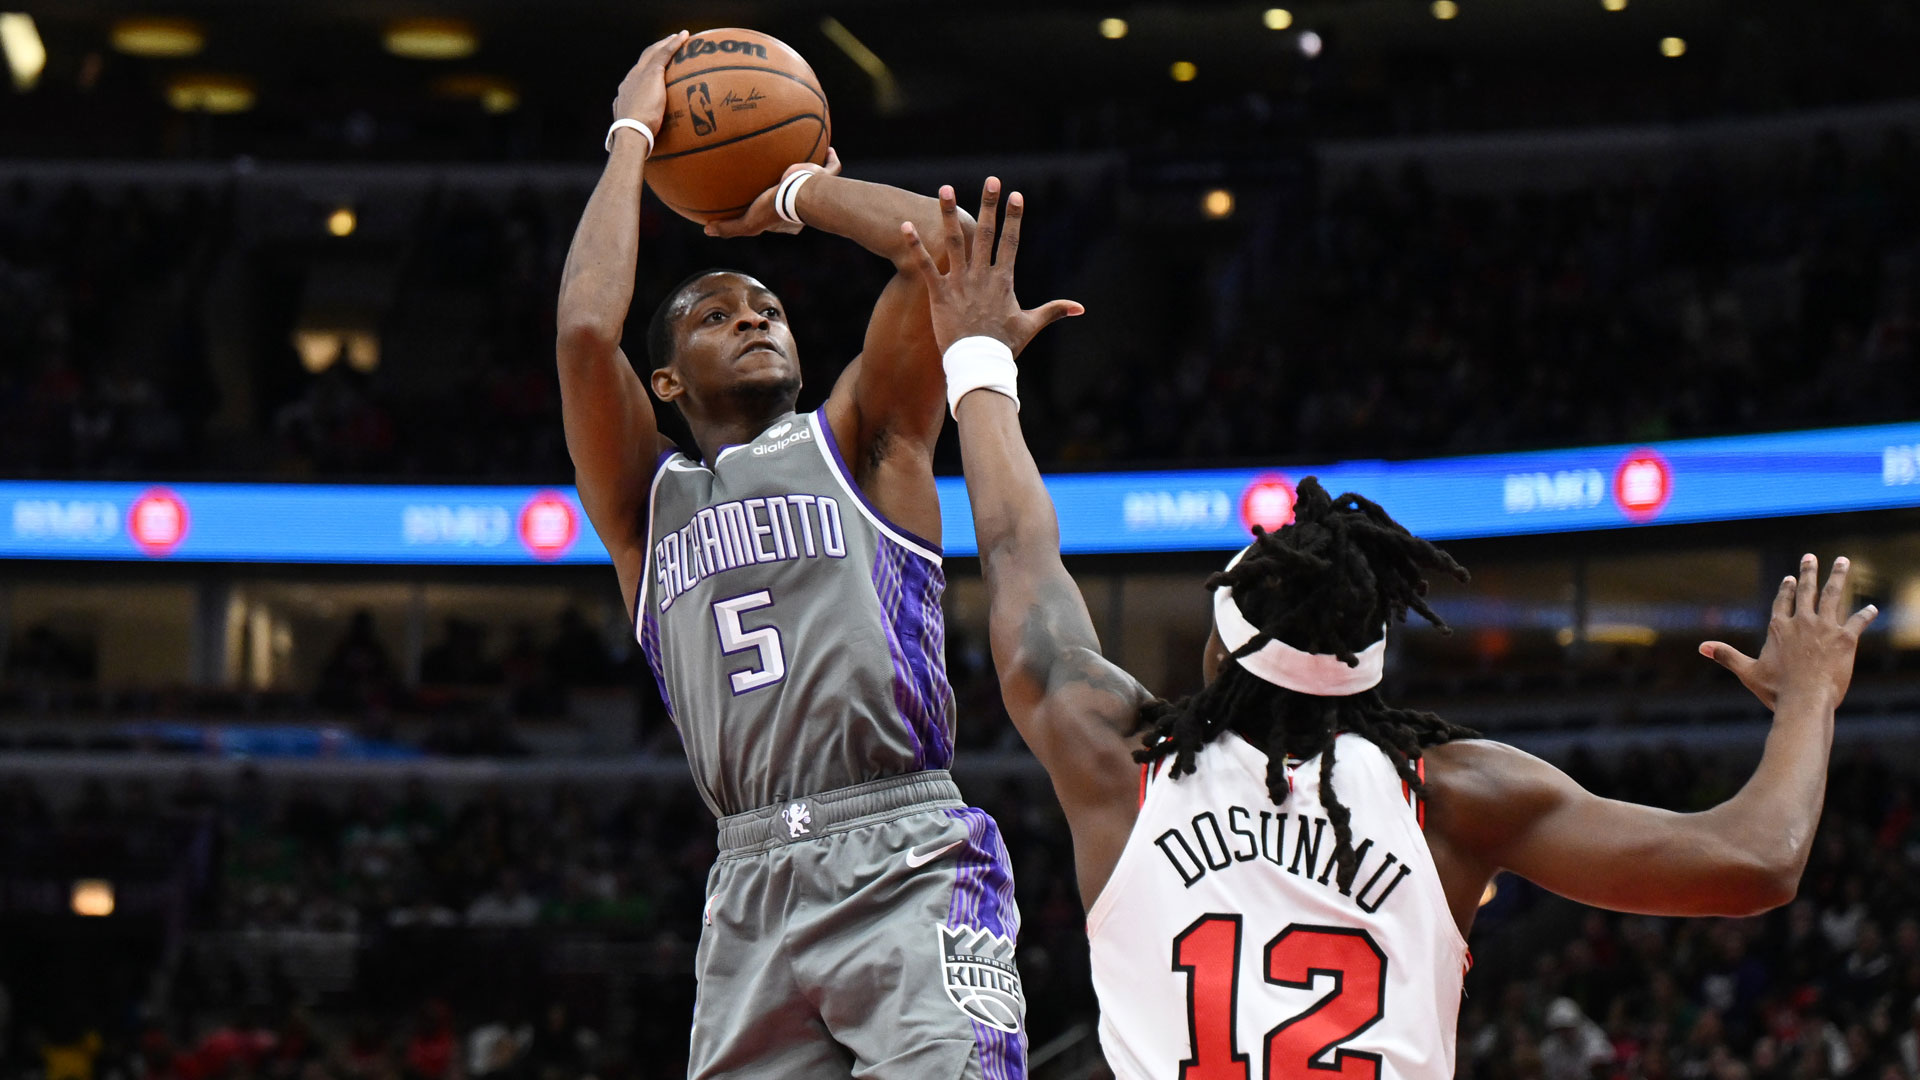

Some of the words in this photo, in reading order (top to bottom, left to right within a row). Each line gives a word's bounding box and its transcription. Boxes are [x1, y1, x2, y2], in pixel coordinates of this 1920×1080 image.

[673, 38, 768, 65] ilson
[753, 427, 811, 455] dialpad
[655, 494, 846, 614] SACRAMENTO
[711, 588, 787, 695] 5
[946, 966, 1020, 1001] KINGS
[1171, 912, 1388, 1080] 12
